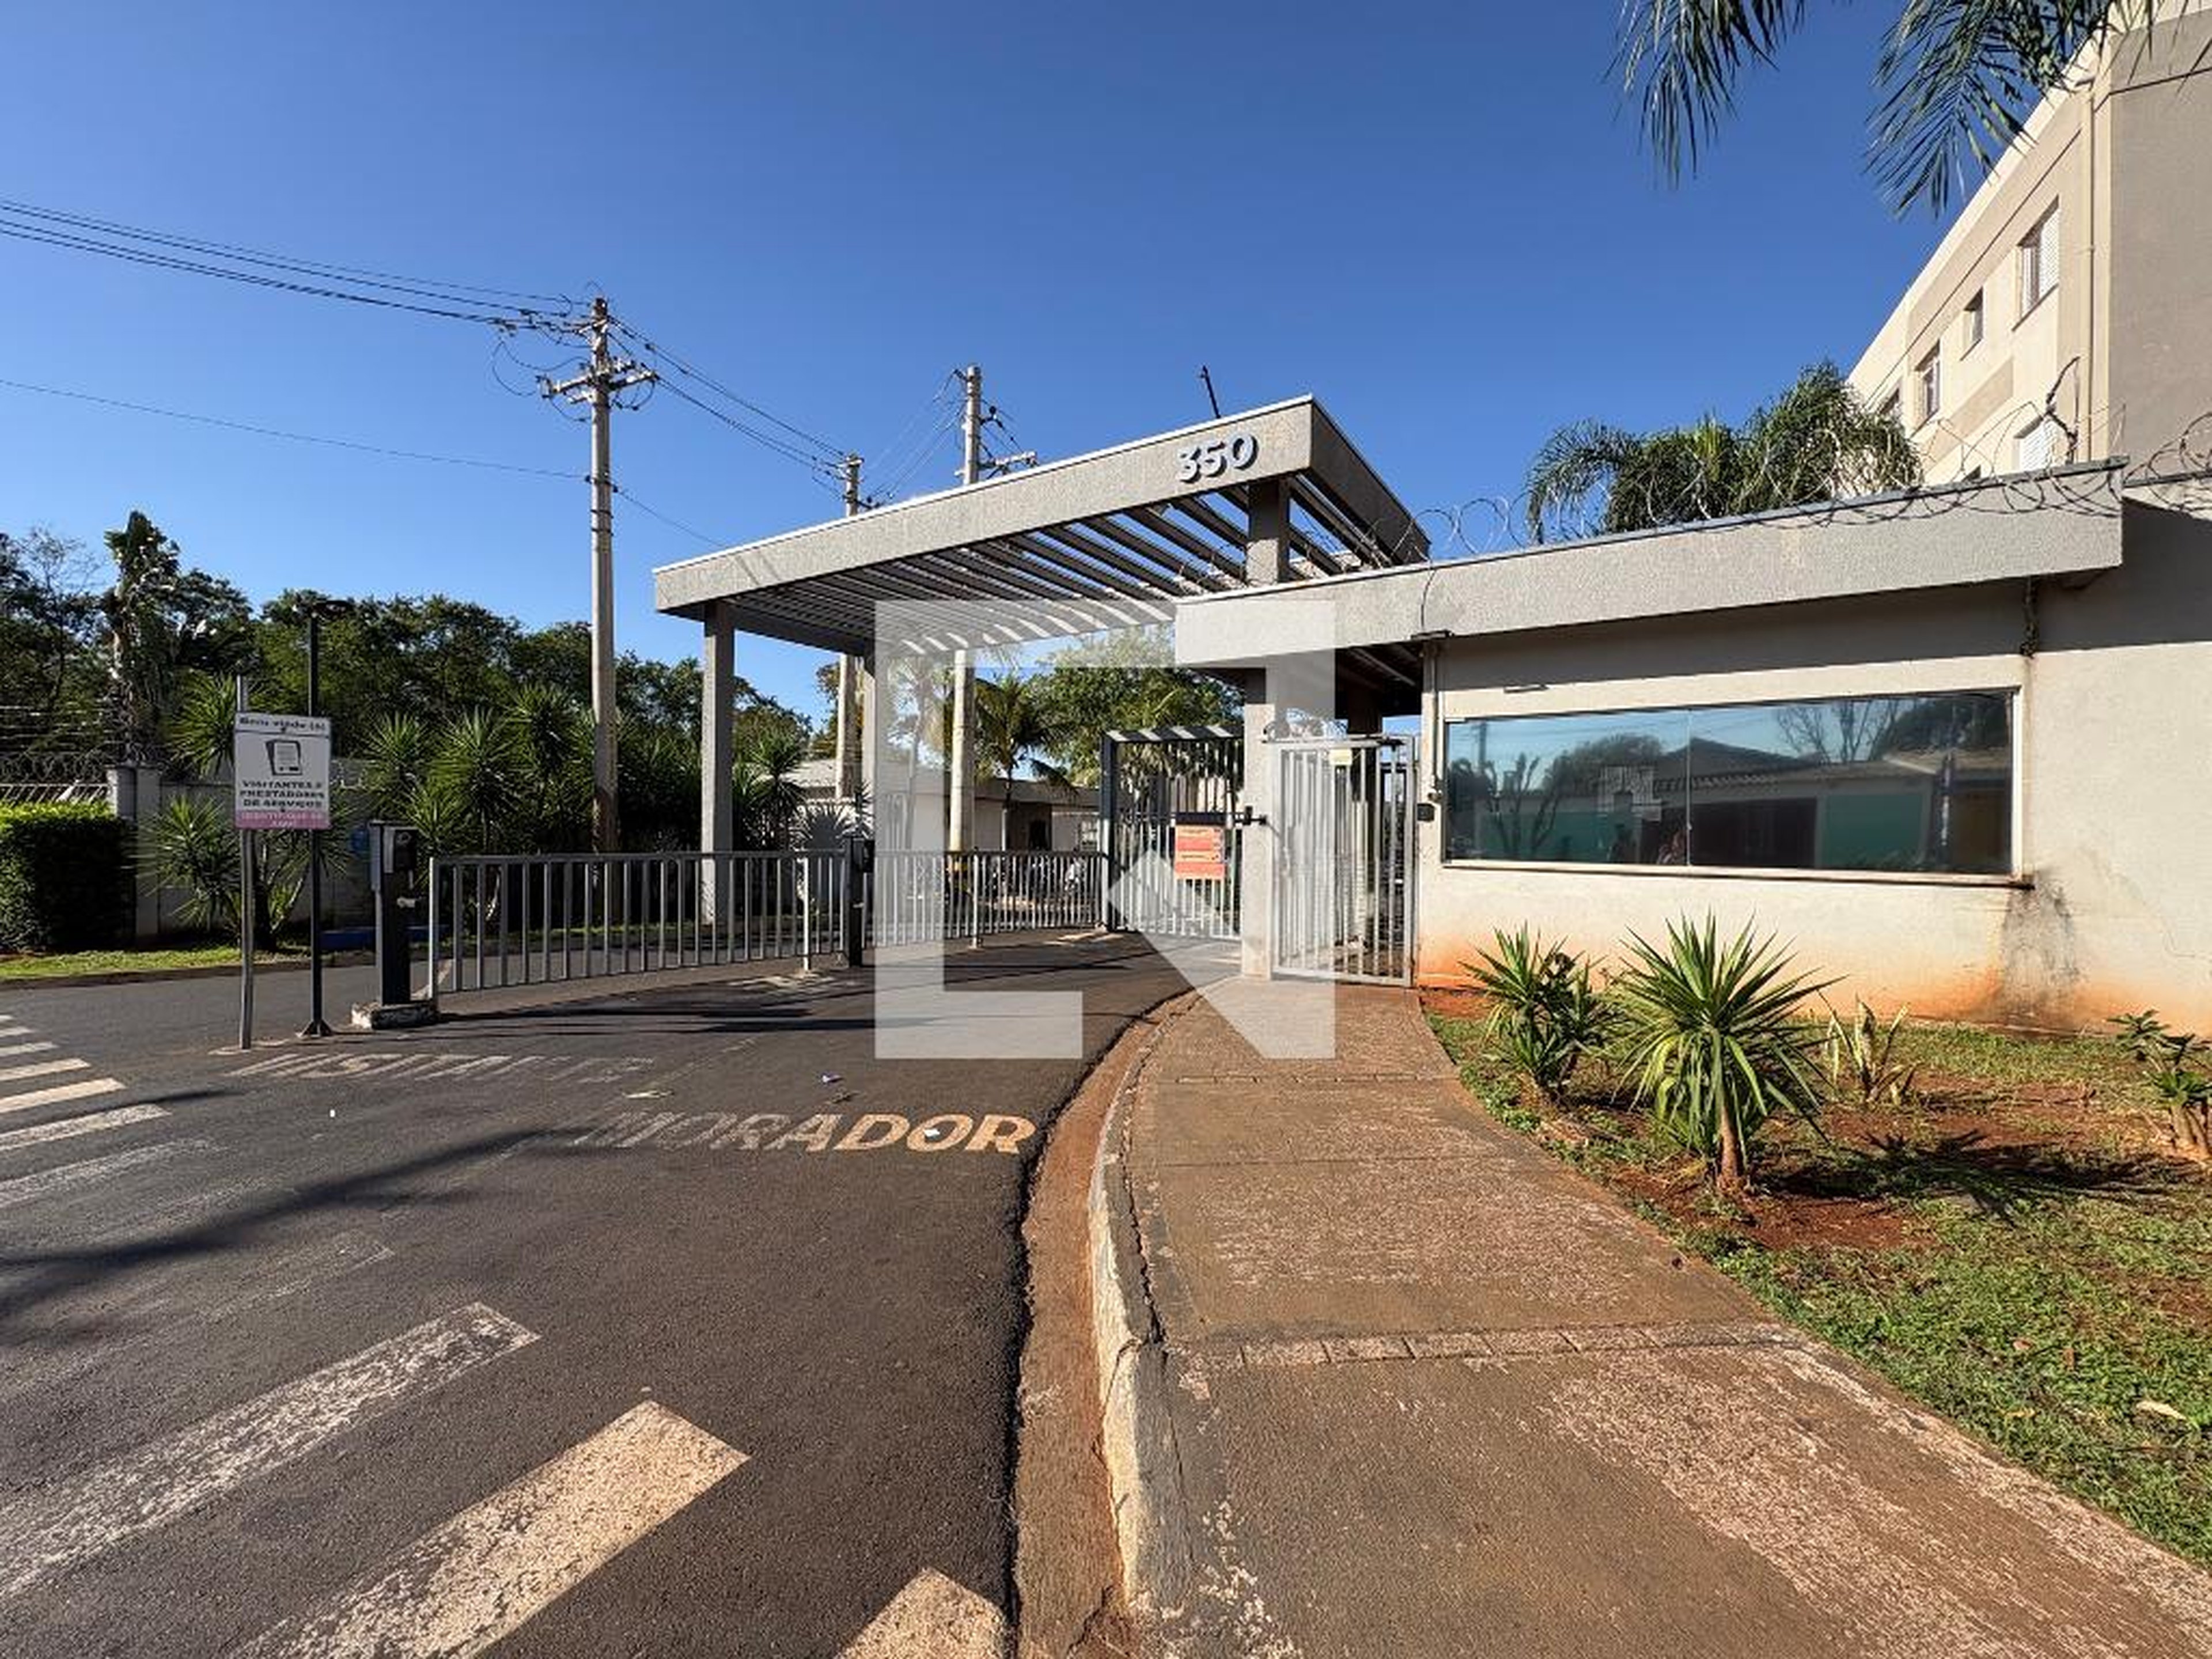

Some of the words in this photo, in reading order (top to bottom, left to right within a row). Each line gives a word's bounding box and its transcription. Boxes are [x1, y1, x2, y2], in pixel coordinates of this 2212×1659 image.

[1177, 433, 1259, 483] 350
[240, 789, 325, 798] PRESTADORES
[242, 780, 312, 789] VISITANTES
[571, 1112, 1037, 1154] MORADOR
